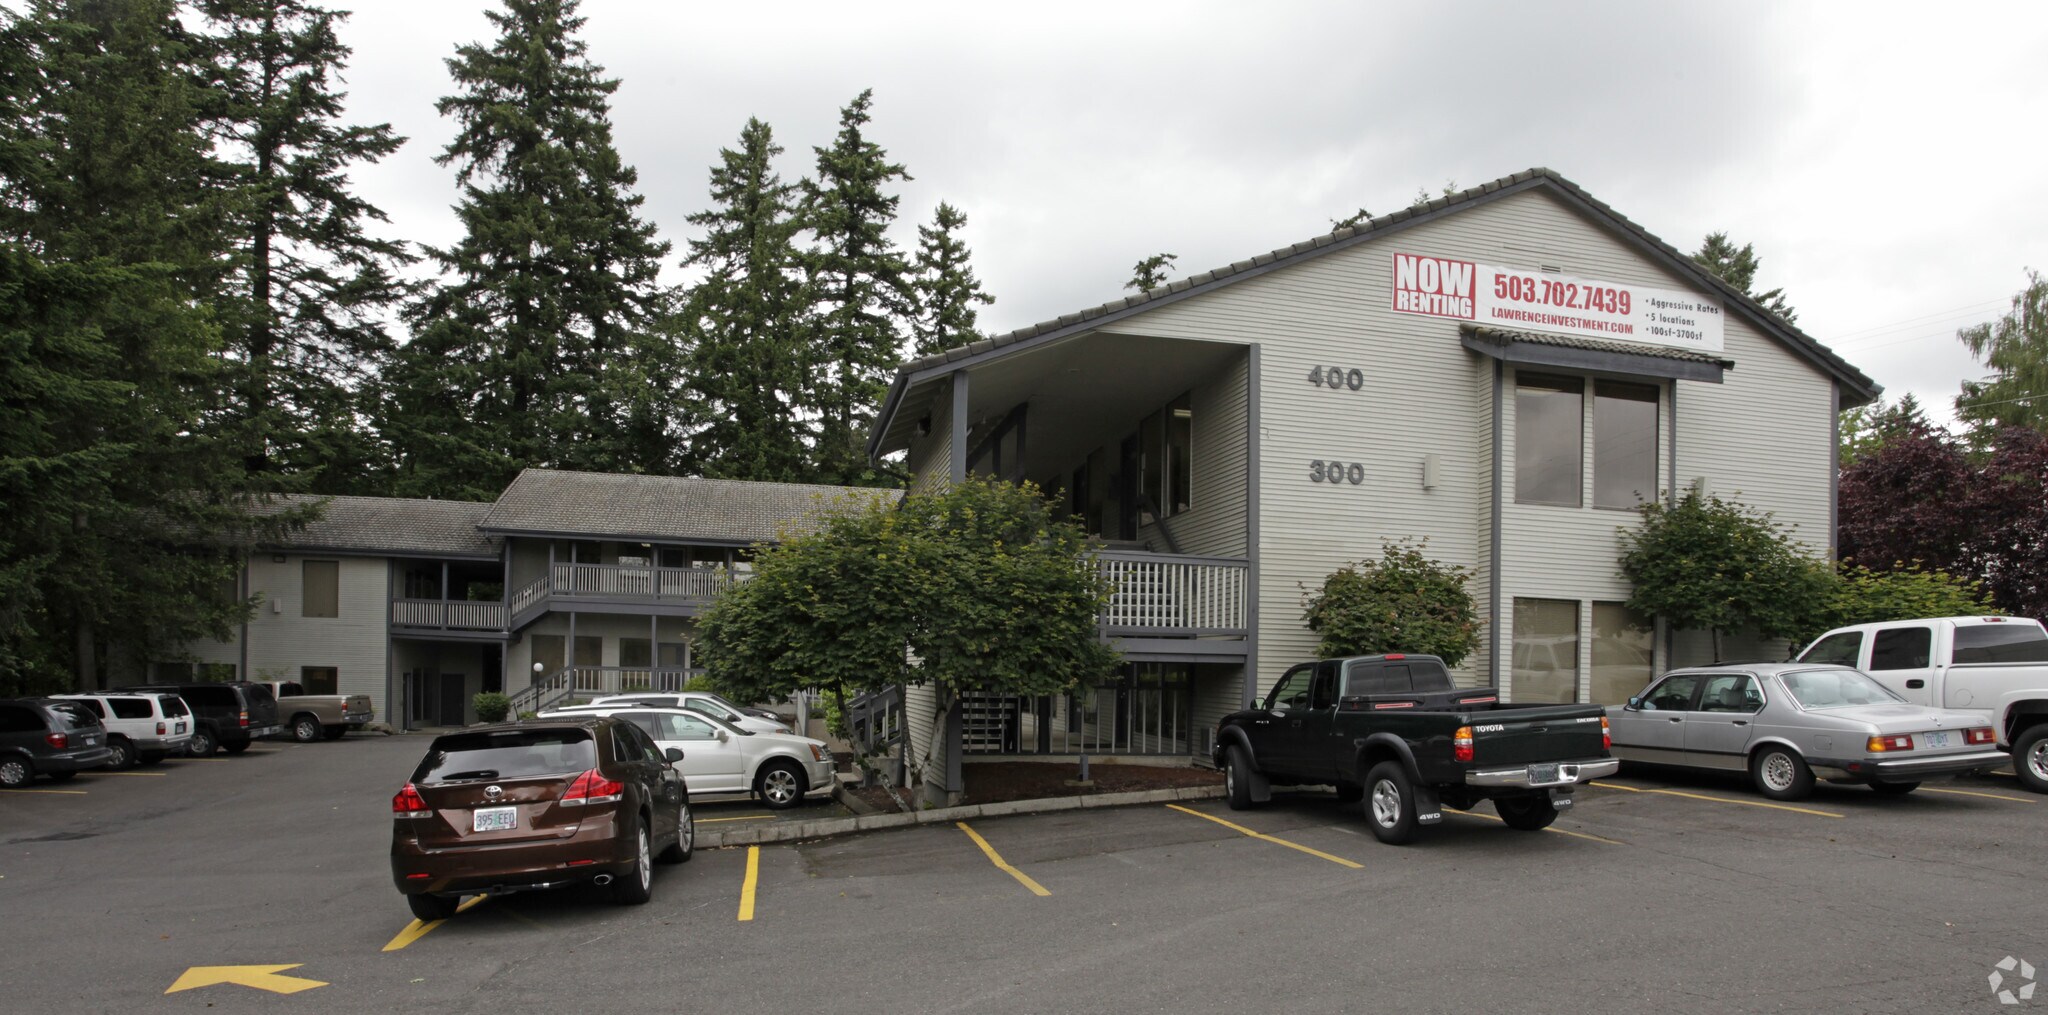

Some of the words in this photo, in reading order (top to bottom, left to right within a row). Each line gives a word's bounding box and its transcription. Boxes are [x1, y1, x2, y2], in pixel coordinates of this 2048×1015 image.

[1397, 254, 1473, 297] NOW
[1397, 290, 1472, 318] RENTING
[1494, 273, 1631, 315] 503.702.7439
[1651, 298, 1693, 311] Aggressive
[1697, 303, 1718, 314] Rates
[1491, 307, 1633, 334] LAWRENCEINVESTMENT.COM
[1651, 313, 1656, 322] 5
[1659, 313, 1695, 326] locations
[1651, 326, 1702, 340] 100sf-3700sf
[1307, 365, 1364, 391] 400
[1309, 460, 1365, 485] 300
[1476, 724, 1504, 733] TOYOTA
[477, 814, 493, 827] 395
[1419, 812, 1441, 820] 4WD
